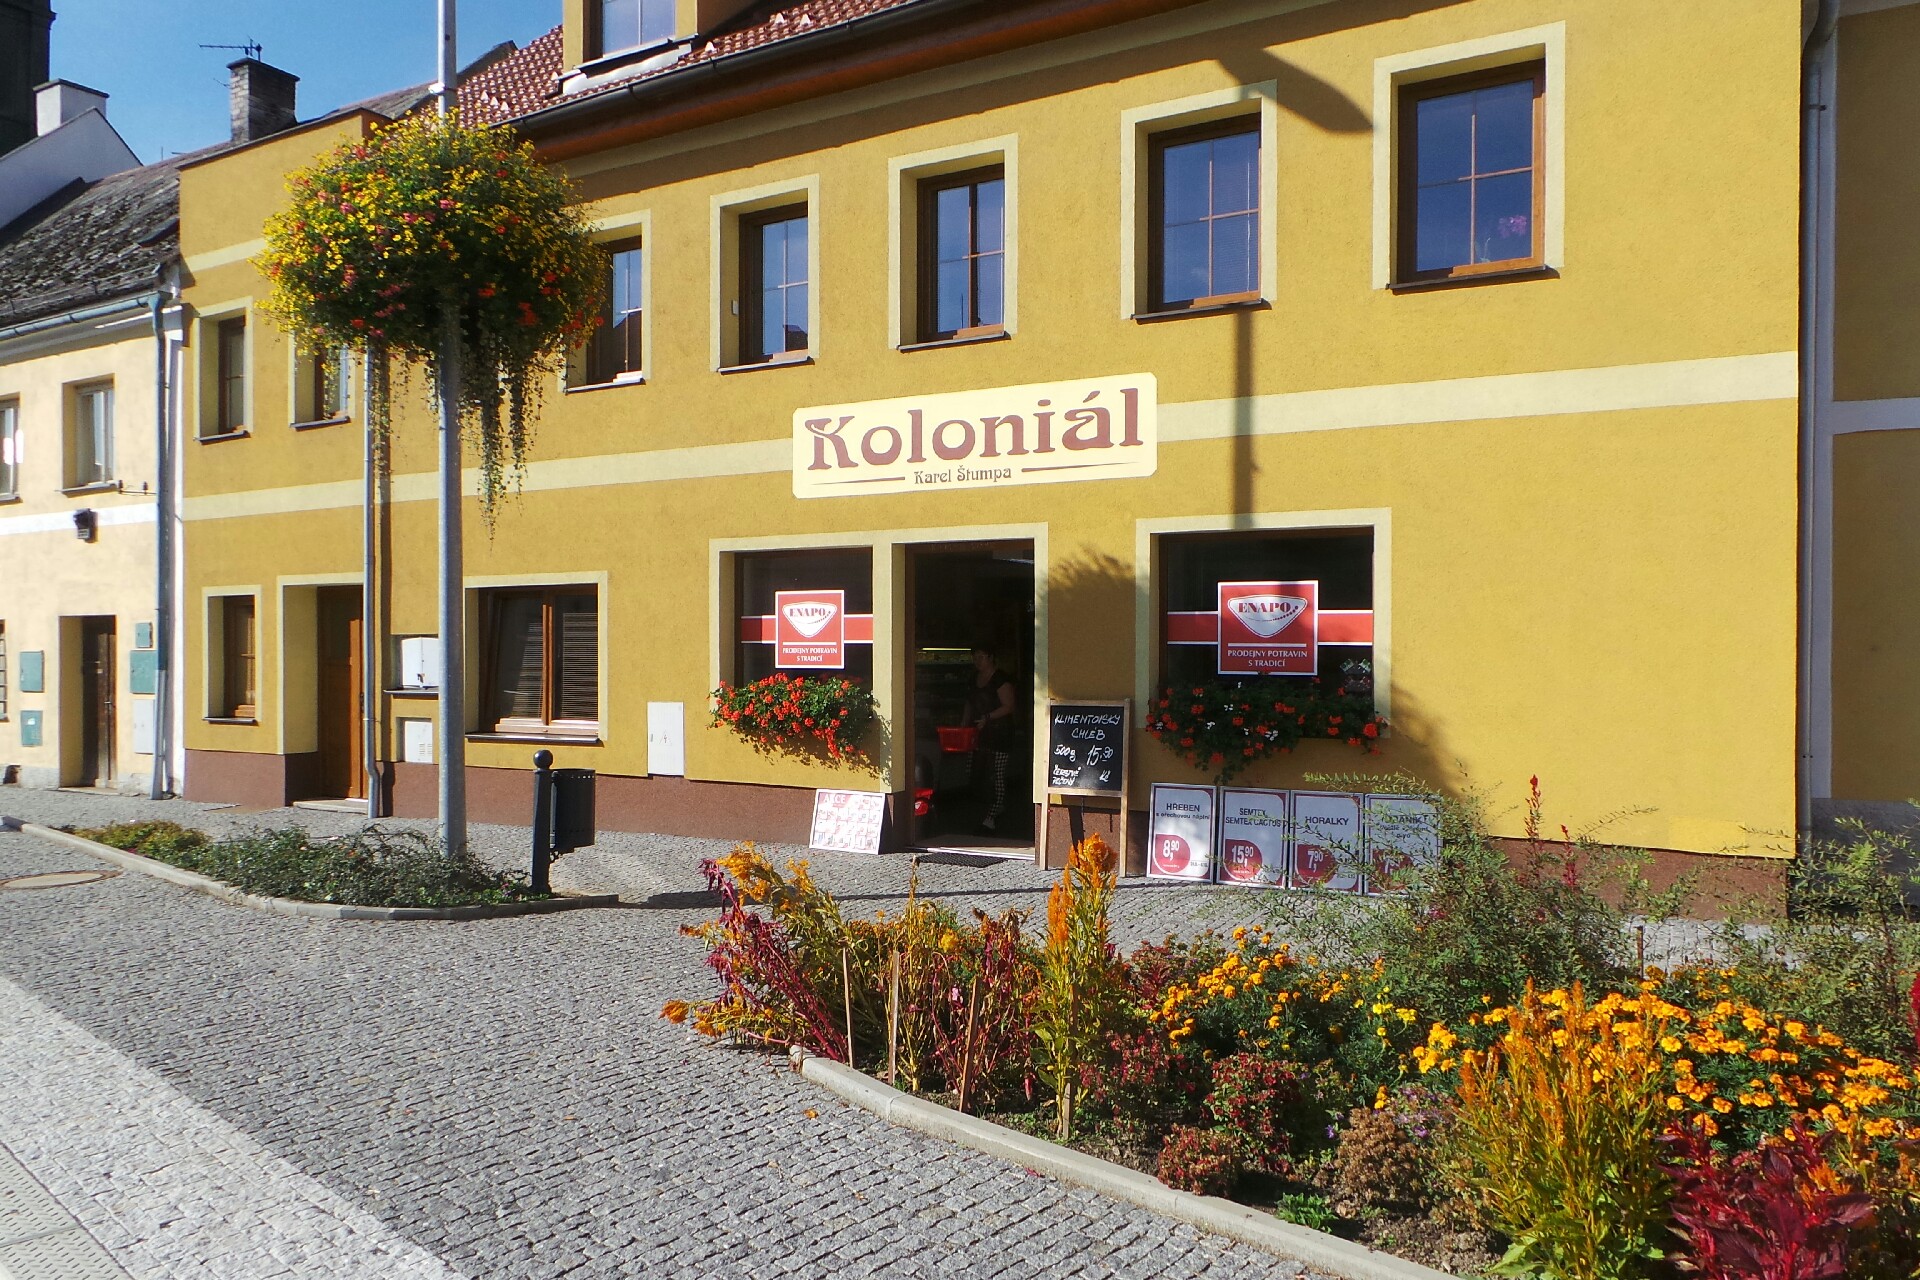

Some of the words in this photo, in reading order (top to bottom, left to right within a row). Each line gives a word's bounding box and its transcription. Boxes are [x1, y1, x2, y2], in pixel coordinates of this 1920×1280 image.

[804, 387, 1144, 471] Koloniál
[914, 469, 952, 485] Karel
[957, 464, 1012, 483] Štumpa
[789, 608, 826, 617] ENAPO
[1238, 602, 1291, 613] ENAPO
[1227, 650, 1265, 658] PRODEJNY
[1267, 650, 1308, 658] POTRAVIN
[1255, 659, 1286, 667] TRADICÍ
[1305, 815, 1349, 826] HORALKY
